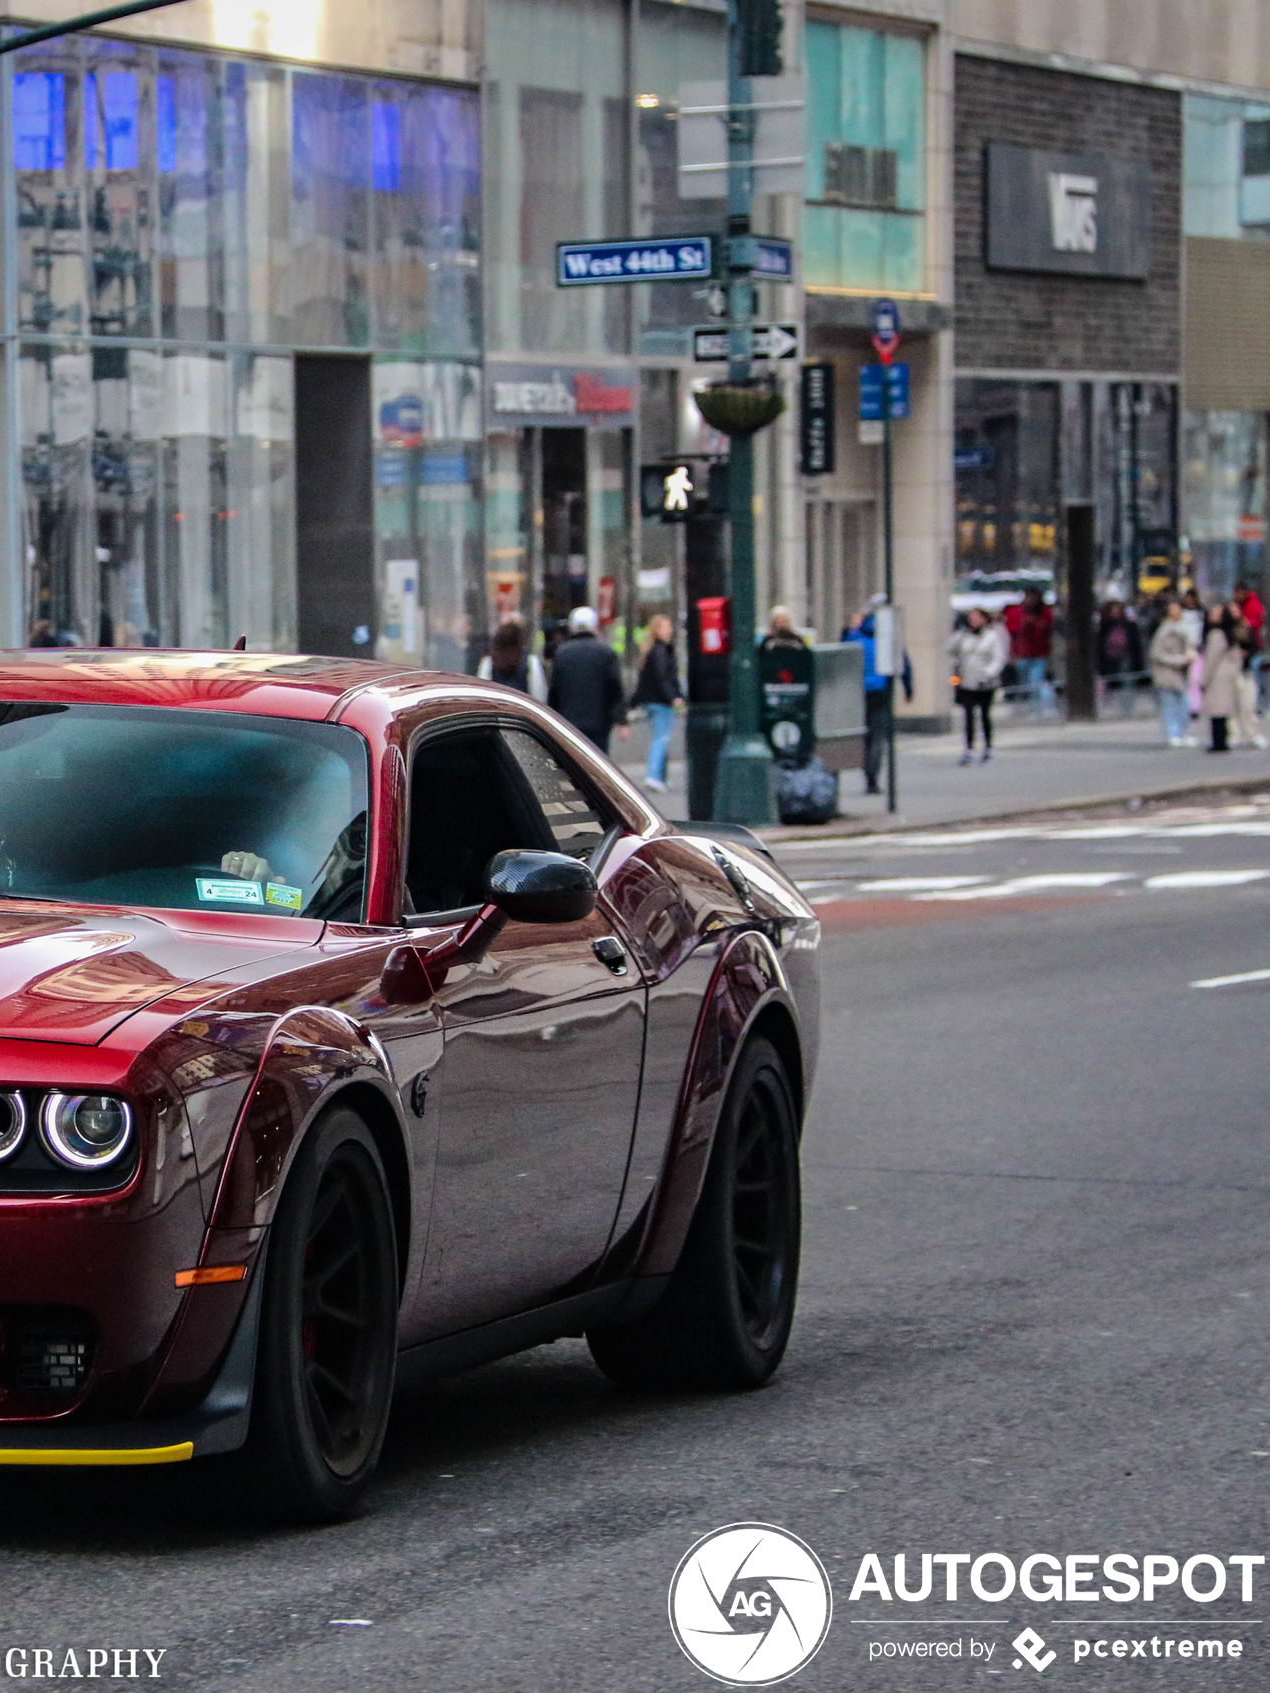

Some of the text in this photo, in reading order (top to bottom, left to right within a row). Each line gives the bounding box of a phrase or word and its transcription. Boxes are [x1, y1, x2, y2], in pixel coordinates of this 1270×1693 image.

[565, 246, 704, 277] West 44th St
[245, 890, 257, 898] 24
